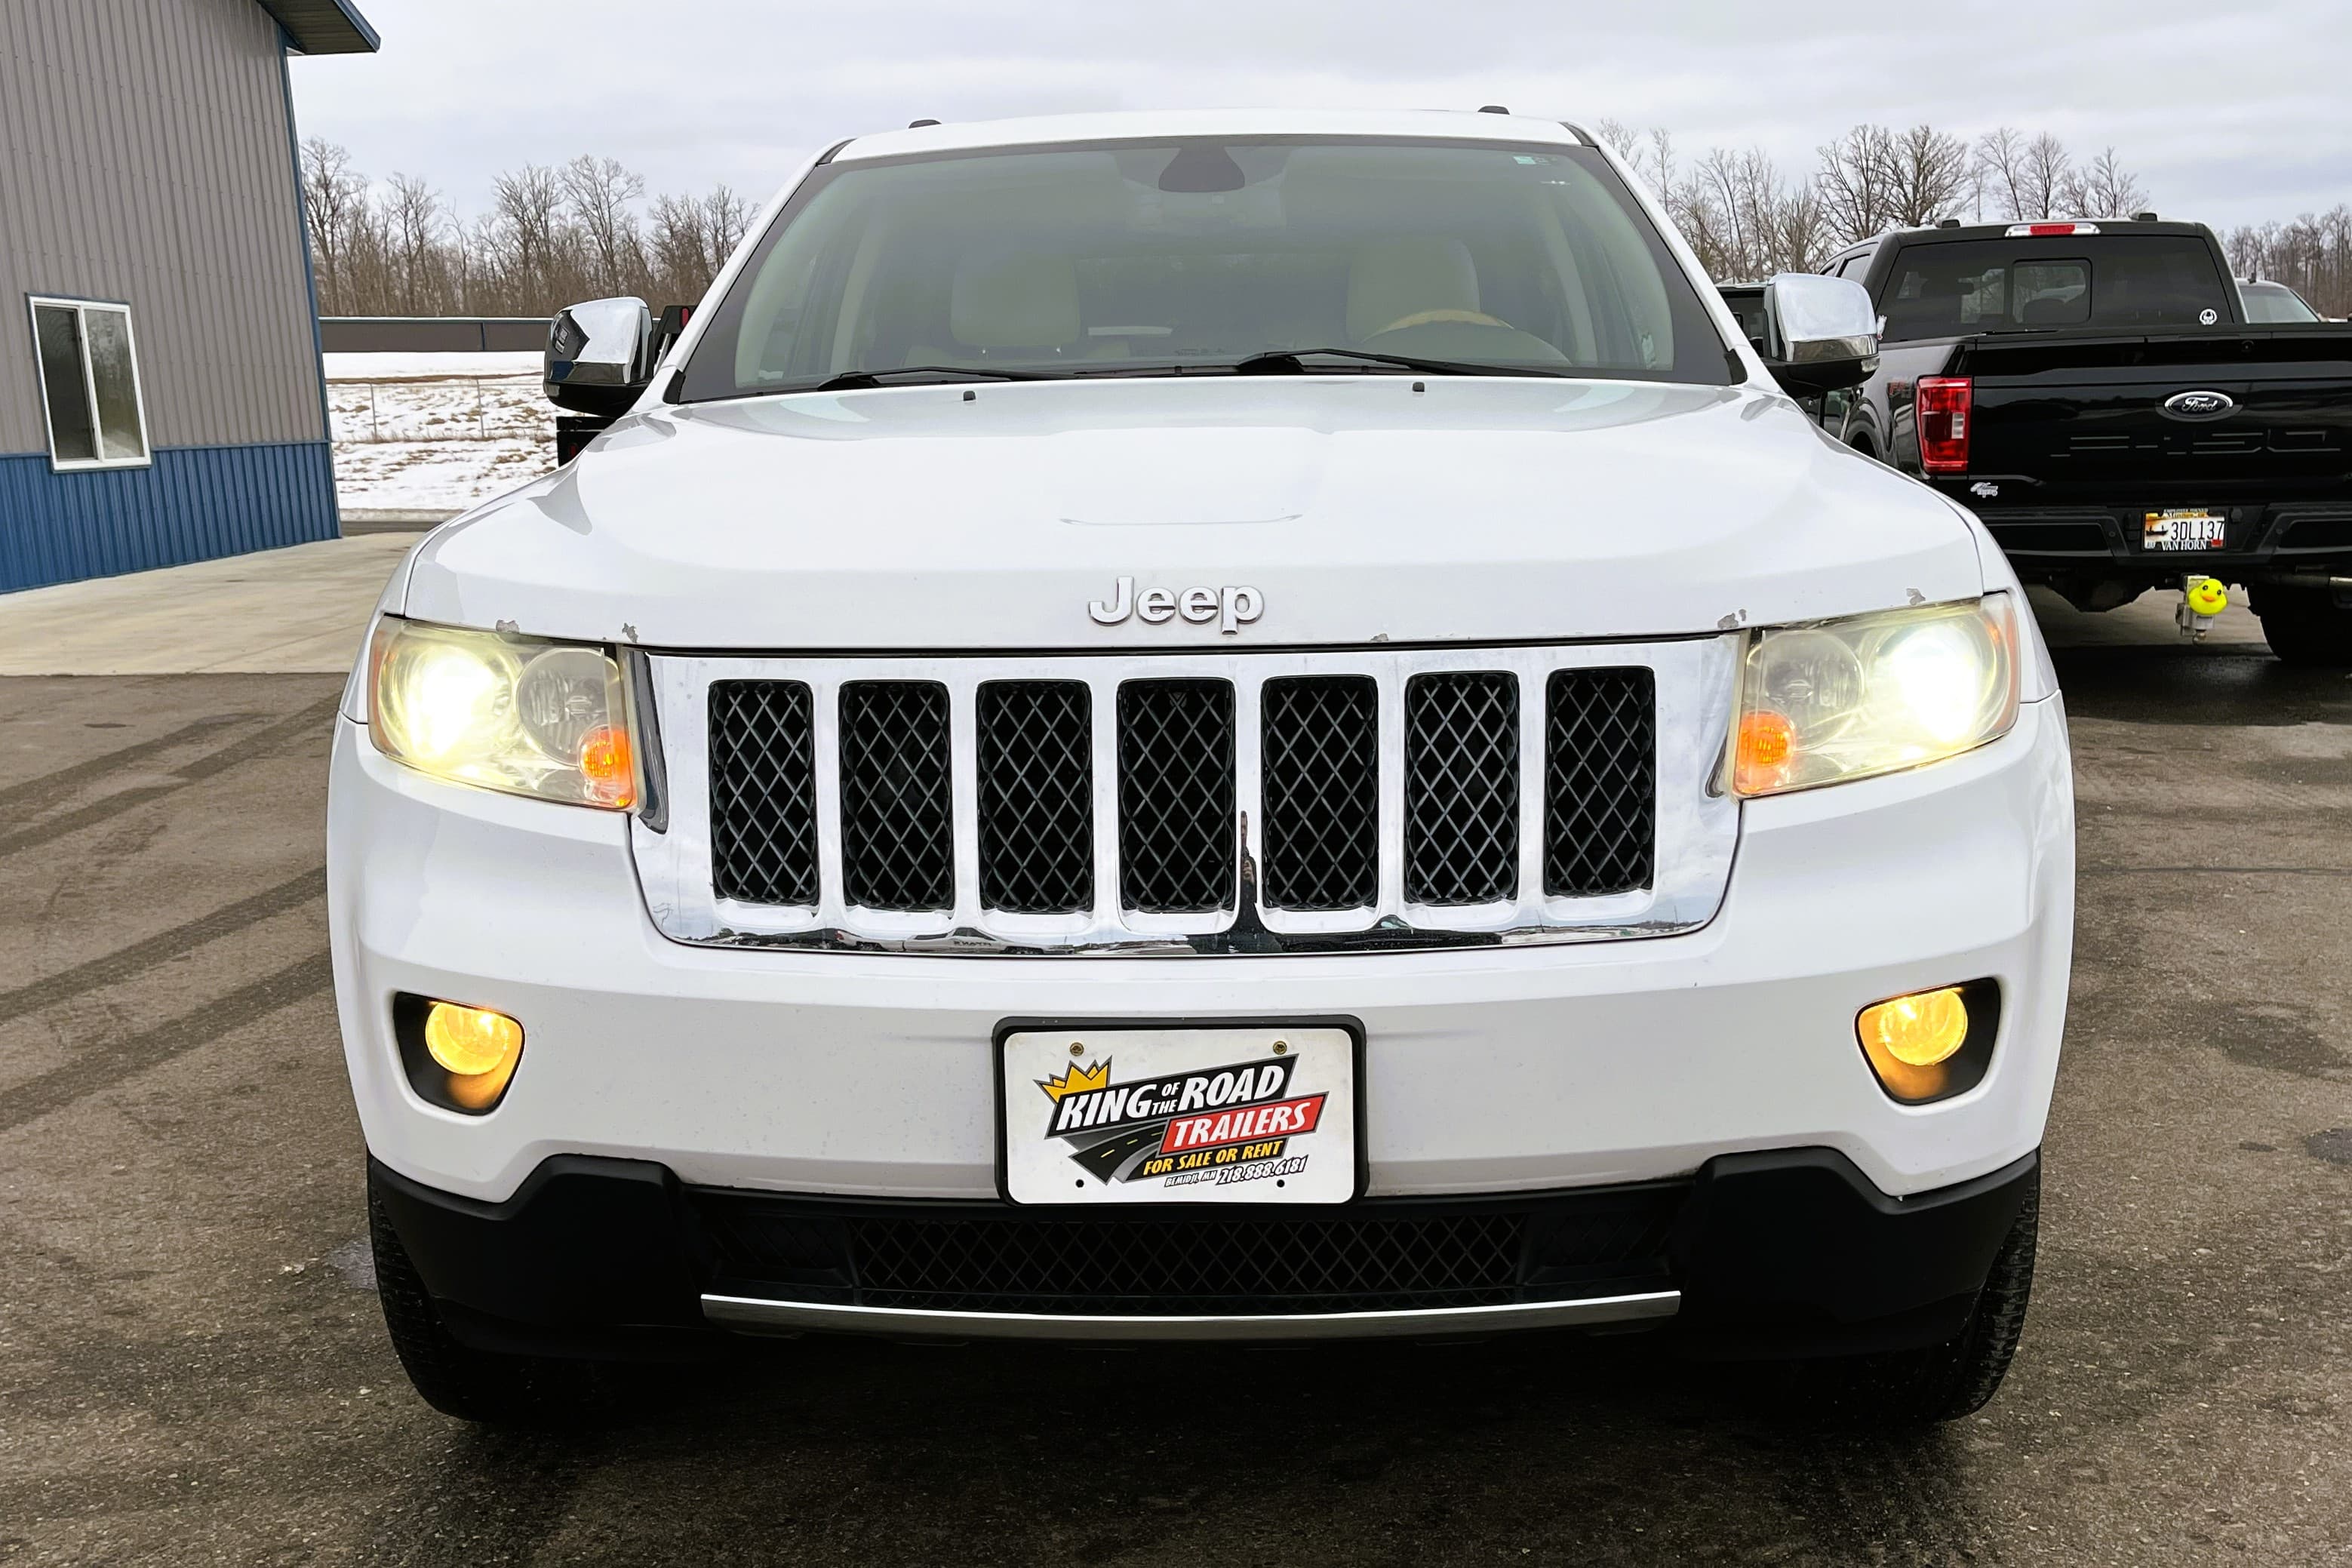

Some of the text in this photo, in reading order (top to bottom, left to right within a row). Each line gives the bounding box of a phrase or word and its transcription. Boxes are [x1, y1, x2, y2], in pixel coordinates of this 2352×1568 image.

[2181, 396, 2218, 411] Ford
[2162, 540, 2207, 551] VAN HORN
[2171, 521, 2225, 540] 3DL137
[1087, 576, 1265, 635] Jeep
[1056, 1065, 1285, 1131] KING OF THE ROAD
[1173, 1102, 1311, 1148] TRAILERS
[1143, 1140, 1284, 1176] FOR SALE OR RENT
[1201, 1170, 1217, 1182] MN
[1216, 1154, 1309, 1185] 218.888.6181
